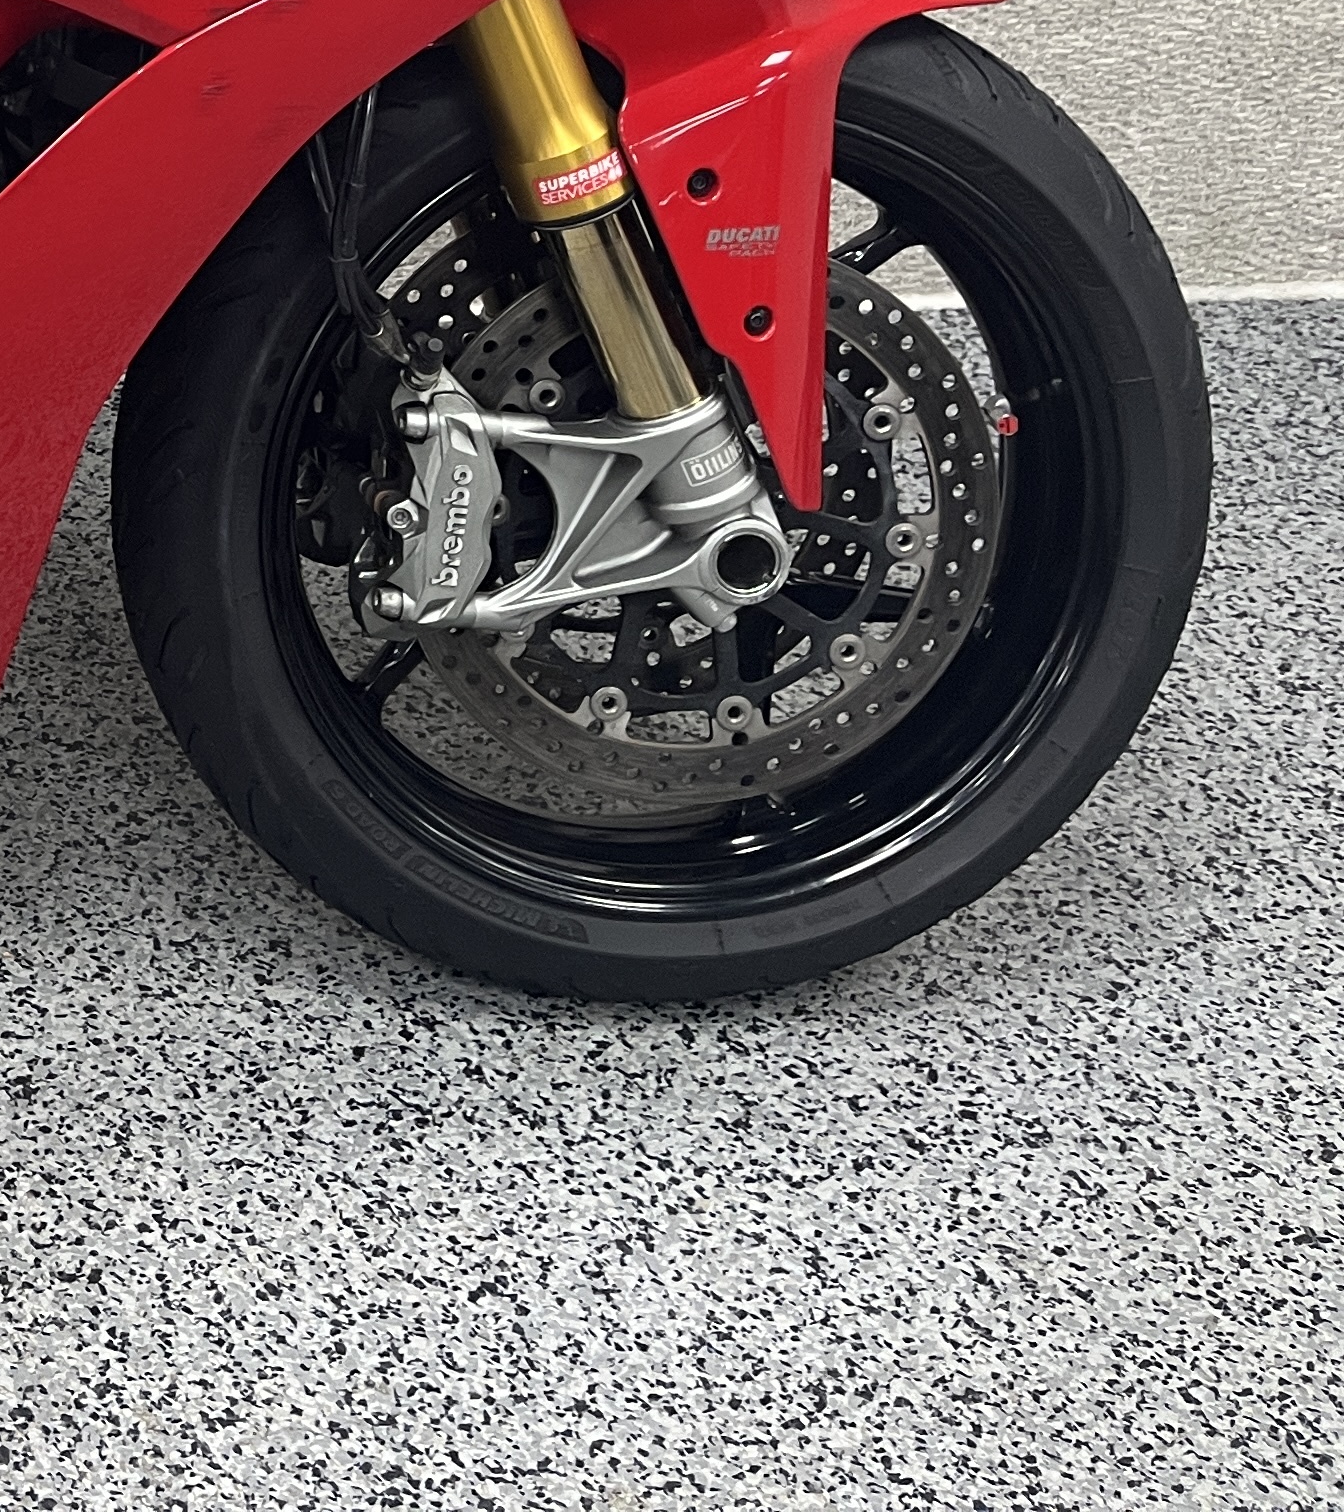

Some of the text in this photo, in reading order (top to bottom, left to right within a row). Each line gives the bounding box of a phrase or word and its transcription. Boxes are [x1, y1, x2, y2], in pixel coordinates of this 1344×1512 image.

[538, 151, 620, 193] SUPERBIKE
[540, 173, 609, 205] SERVICES
[706, 225, 780, 243] DUCATI
[431, 464, 473, 586] brembo
